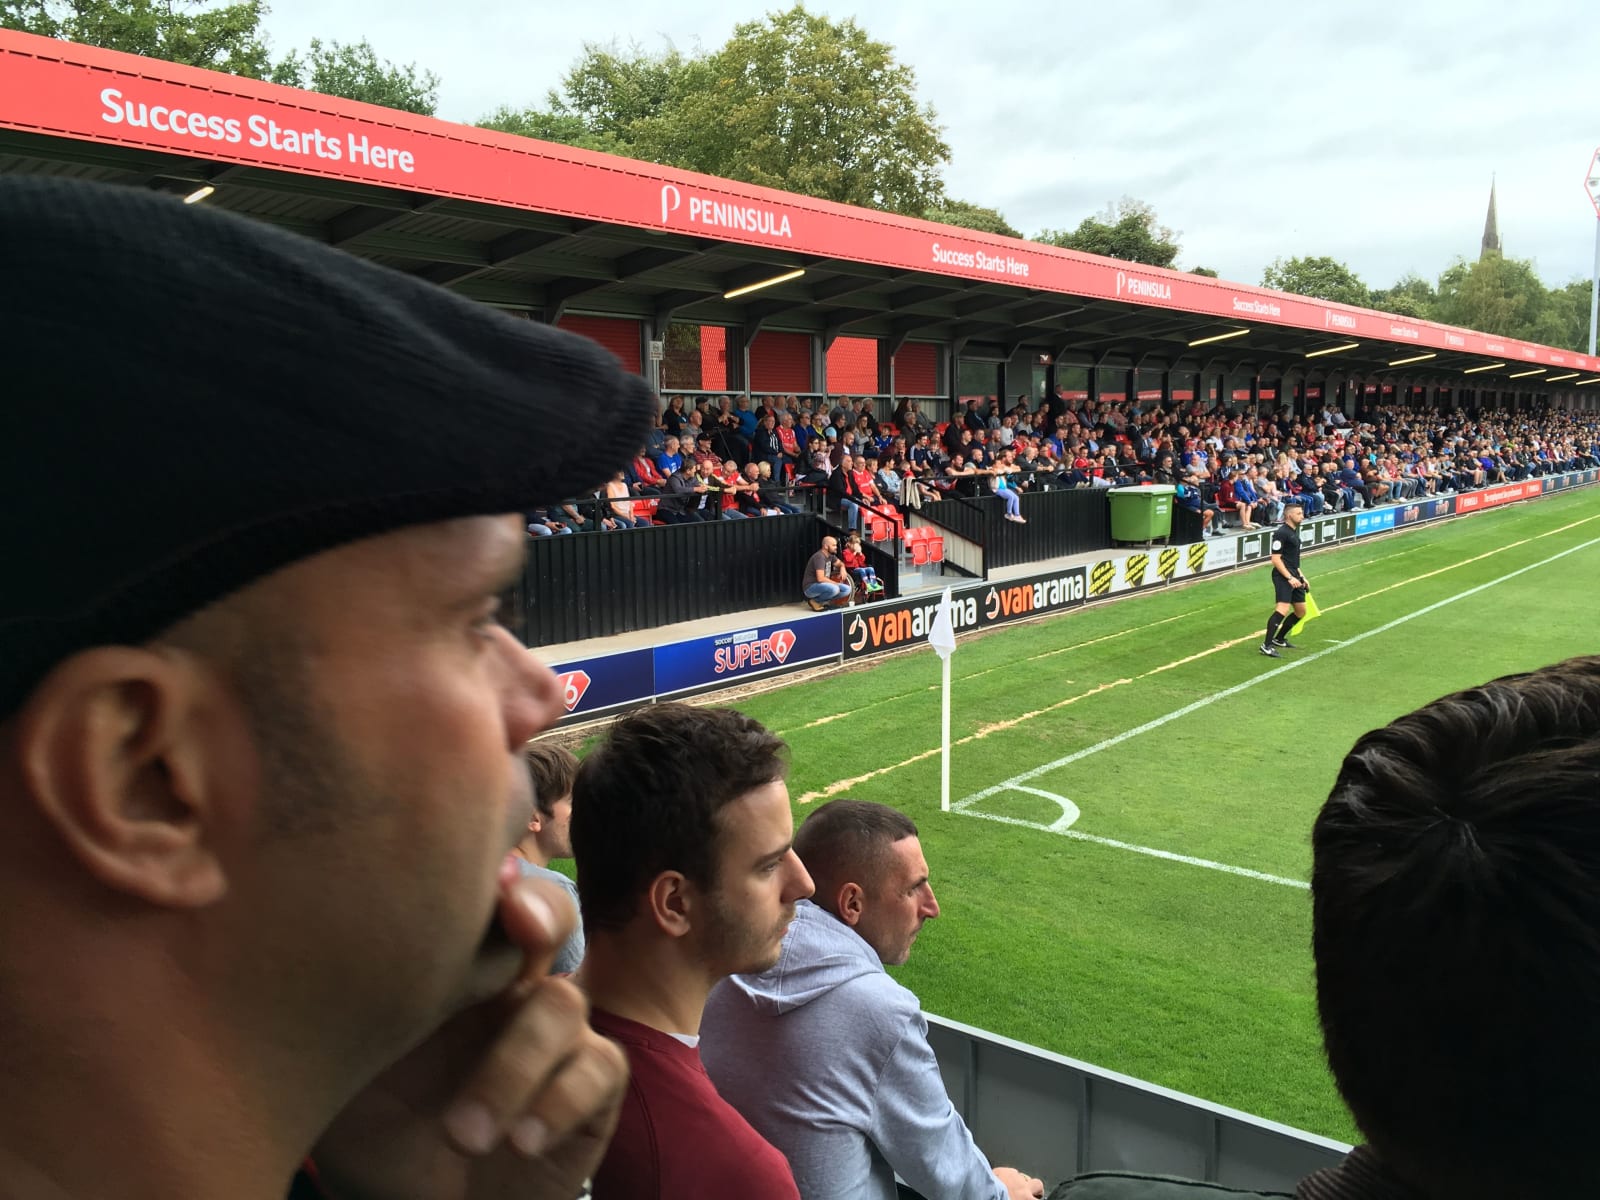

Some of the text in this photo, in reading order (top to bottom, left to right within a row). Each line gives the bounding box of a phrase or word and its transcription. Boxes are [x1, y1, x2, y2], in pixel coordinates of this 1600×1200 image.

[100, 88, 415, 173] Success Starts Here
[689, 196, 793, 239] PENINSULA
[932, 243, 1030, 277] Success Starts Here
[1127, 278, 1172, 300] PENINSULA
[1000, 574, 1084, 617] vanarama
[714, 638, 772, 674] SUPER
